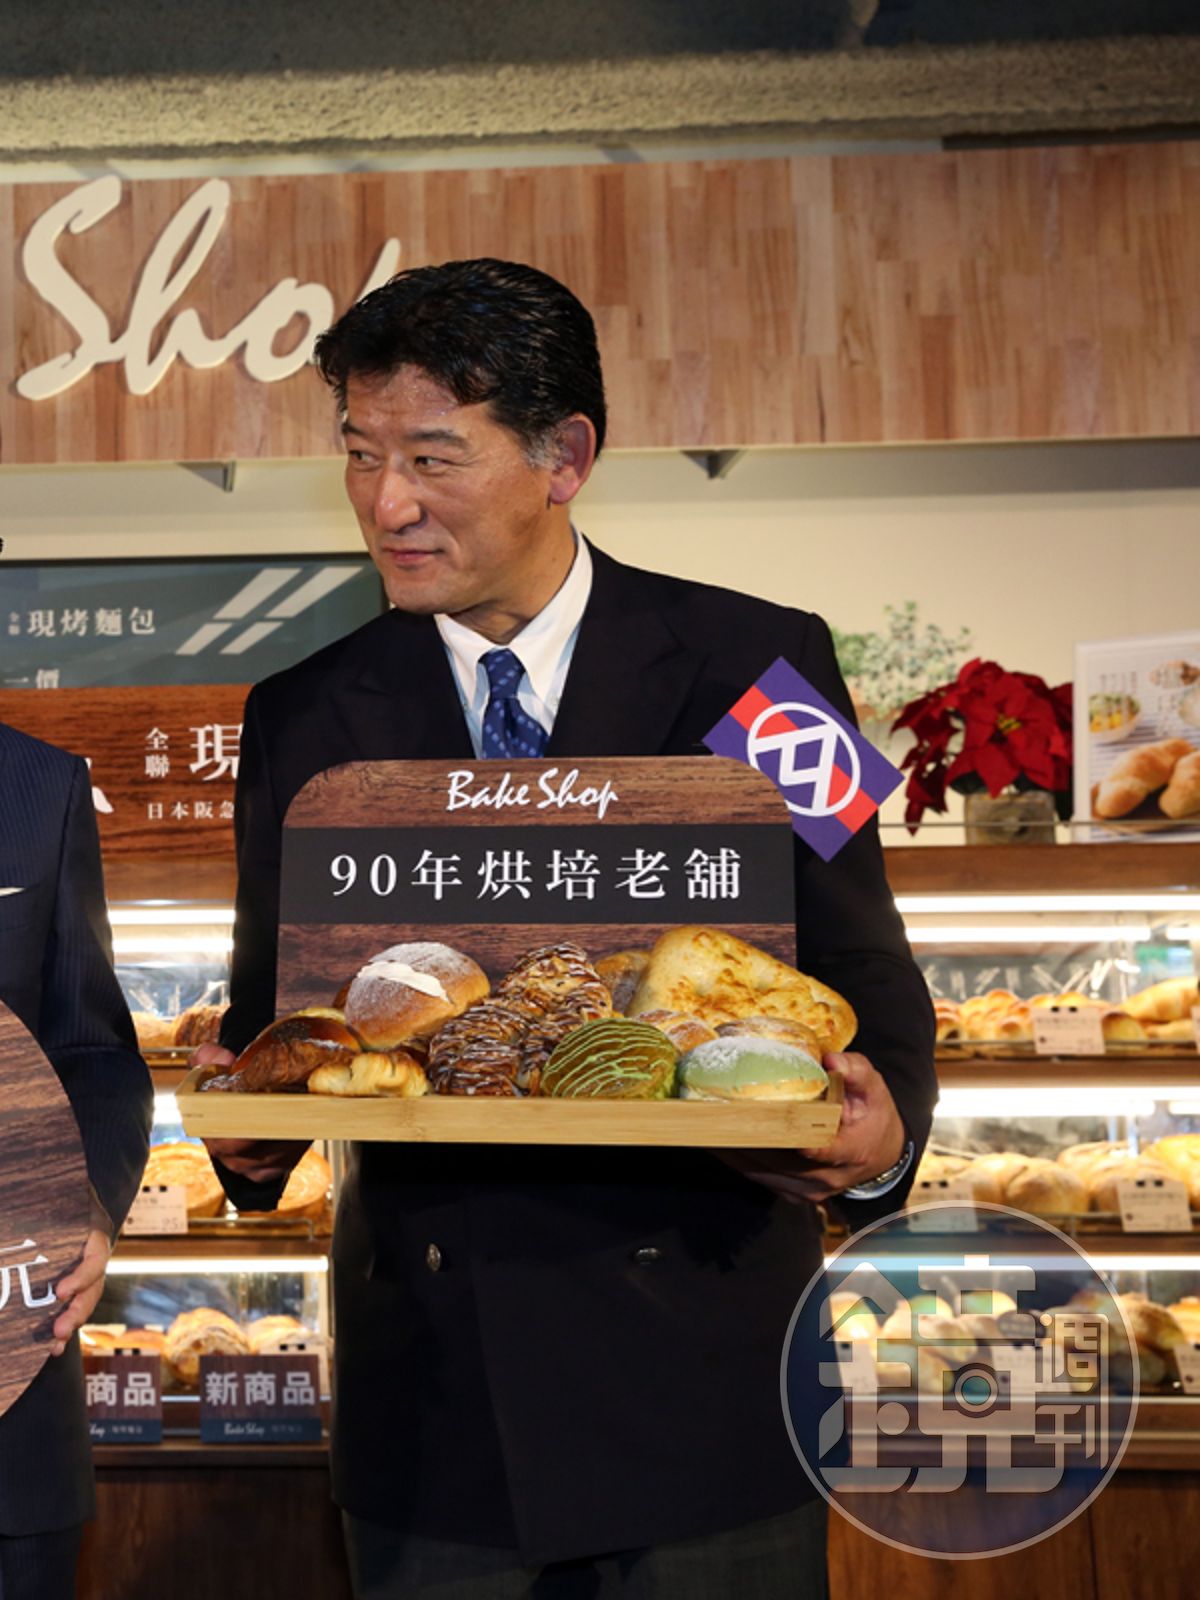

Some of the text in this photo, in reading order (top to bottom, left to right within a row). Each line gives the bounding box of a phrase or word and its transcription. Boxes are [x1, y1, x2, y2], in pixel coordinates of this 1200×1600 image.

[27, 607, 156, 637] 現烤麵包
[145, 727, 170, 779] 全聯
[446, 767, 618, 820] Bake Shop
[330, 847, 742, 902] 90年烘培老舖
[205, 1371, 315, 1406] 新商品
